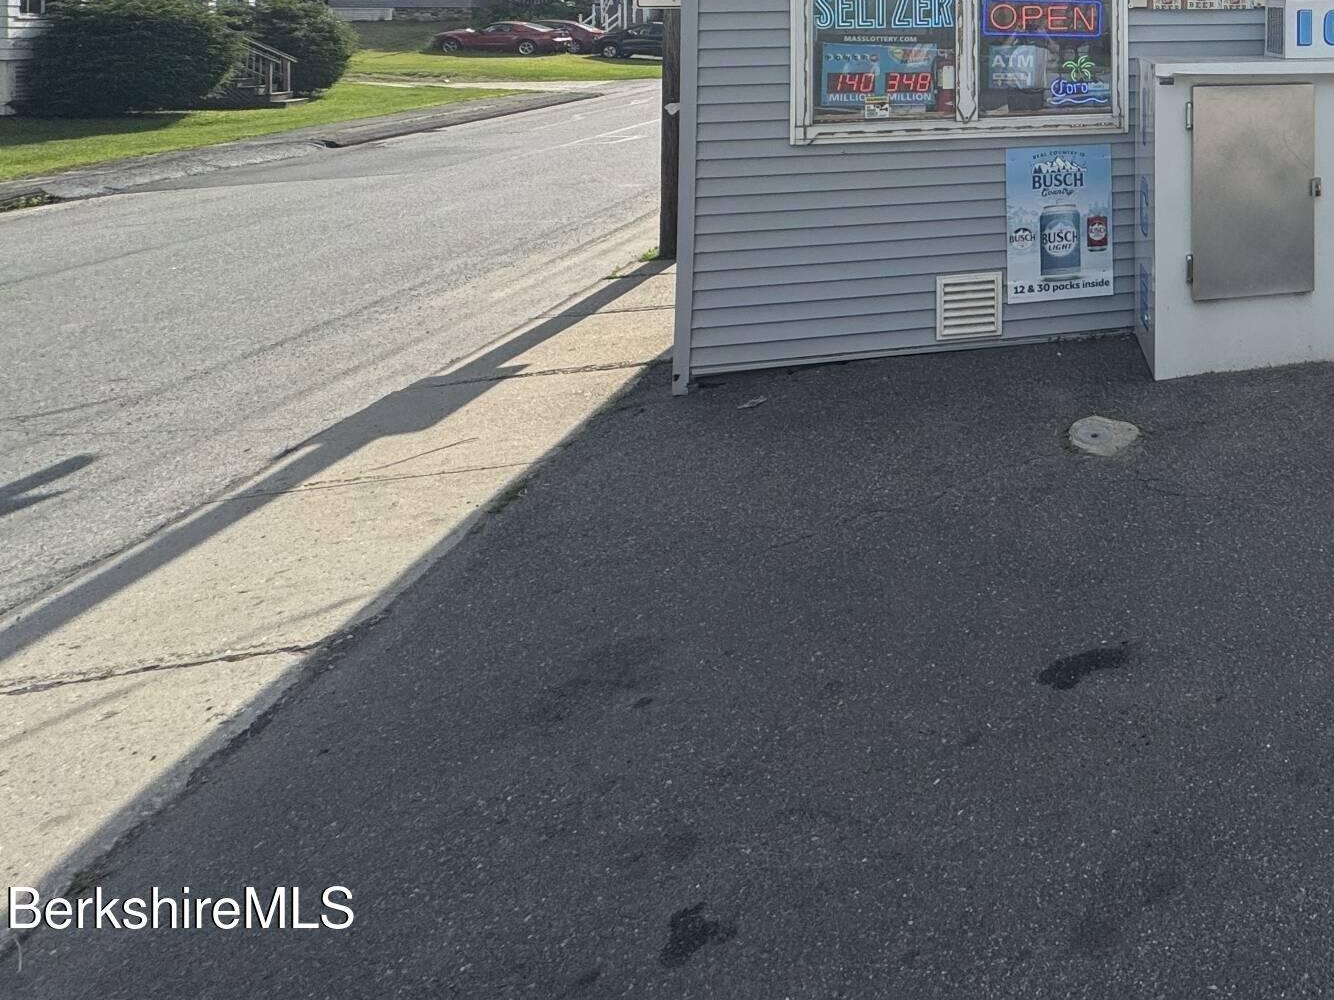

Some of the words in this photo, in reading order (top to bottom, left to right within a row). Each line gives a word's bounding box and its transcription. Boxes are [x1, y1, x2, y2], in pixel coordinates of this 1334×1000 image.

[1189, 1, 1214, 9] BEER
[989, 3, 1096, 32] OPEN
[844, 35, 918, 43] MASSLOTTERY.COM
[991, 54, 1034, 68] ATM
[836, 72, 875, 92] 140
[887, 72, 931, 92] 348
[1050, 79, 1089, 97] Coro
[888, 92, 932, 101] MILLION
[1032, 173, 1084, 190] BUSCH
[1009, 232, 1036, 243] BUSCH
[1042, 230, 1078, 245] BUSCH
[1048, 243, 1073, 251] LIGHT
[1013, 285, 1025, 295] 12
[1028, 284, 1035, 293] &
[1037, 283, 1050, 292] 30
[1052, 280, 1081, 293] packs
[1082, 278, 1110, 289] inside
